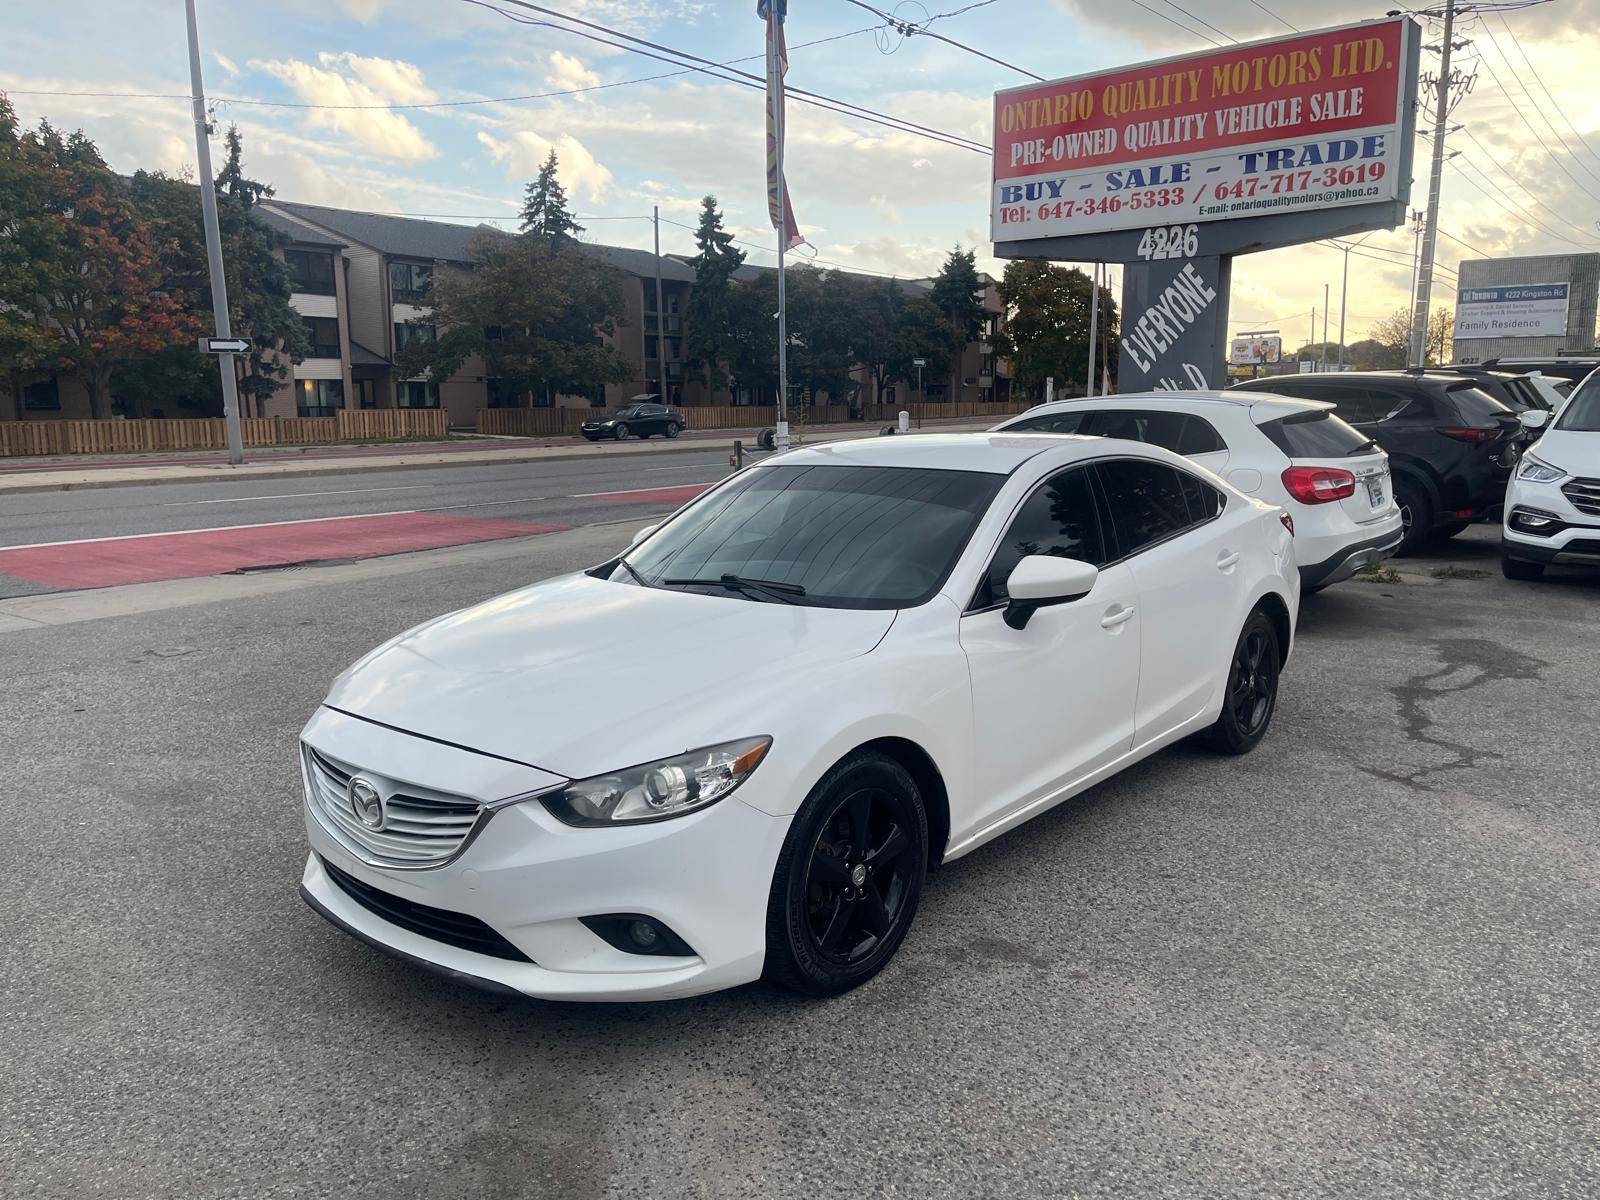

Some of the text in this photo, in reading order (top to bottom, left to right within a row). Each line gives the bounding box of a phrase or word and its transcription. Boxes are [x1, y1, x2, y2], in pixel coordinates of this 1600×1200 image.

[1001, 37, 1393, 133] ONTARIO QUALITY MOTORS LTD.
[1010, 87, 1364, 167] PRE-OWNED QUALITY VEHICLE SALE
[1000, 179, 1067, 204] BUY
[1106, 162, 1192, 191] SALE
[1238, 134, 1386, 174] TRADE
[1000, 206, 1031, 224] Tel:
[1037, 187, 1185, 221] 647-346-5333
[1214, 162, 1386, 200] 647-717-3619
[1199, 185, 1379, 215] E-mail: ontarioqualitymotors@yahoo.ca
[1137, 223, 1199, 260] 4226
[1121, 262, 1217, 374] EVERYONE
[1460, 319, 1541, 331] Family Residence
[1504, 290, 1521, 299] 4222
[1522, 289, 1552, 299] Kingston
